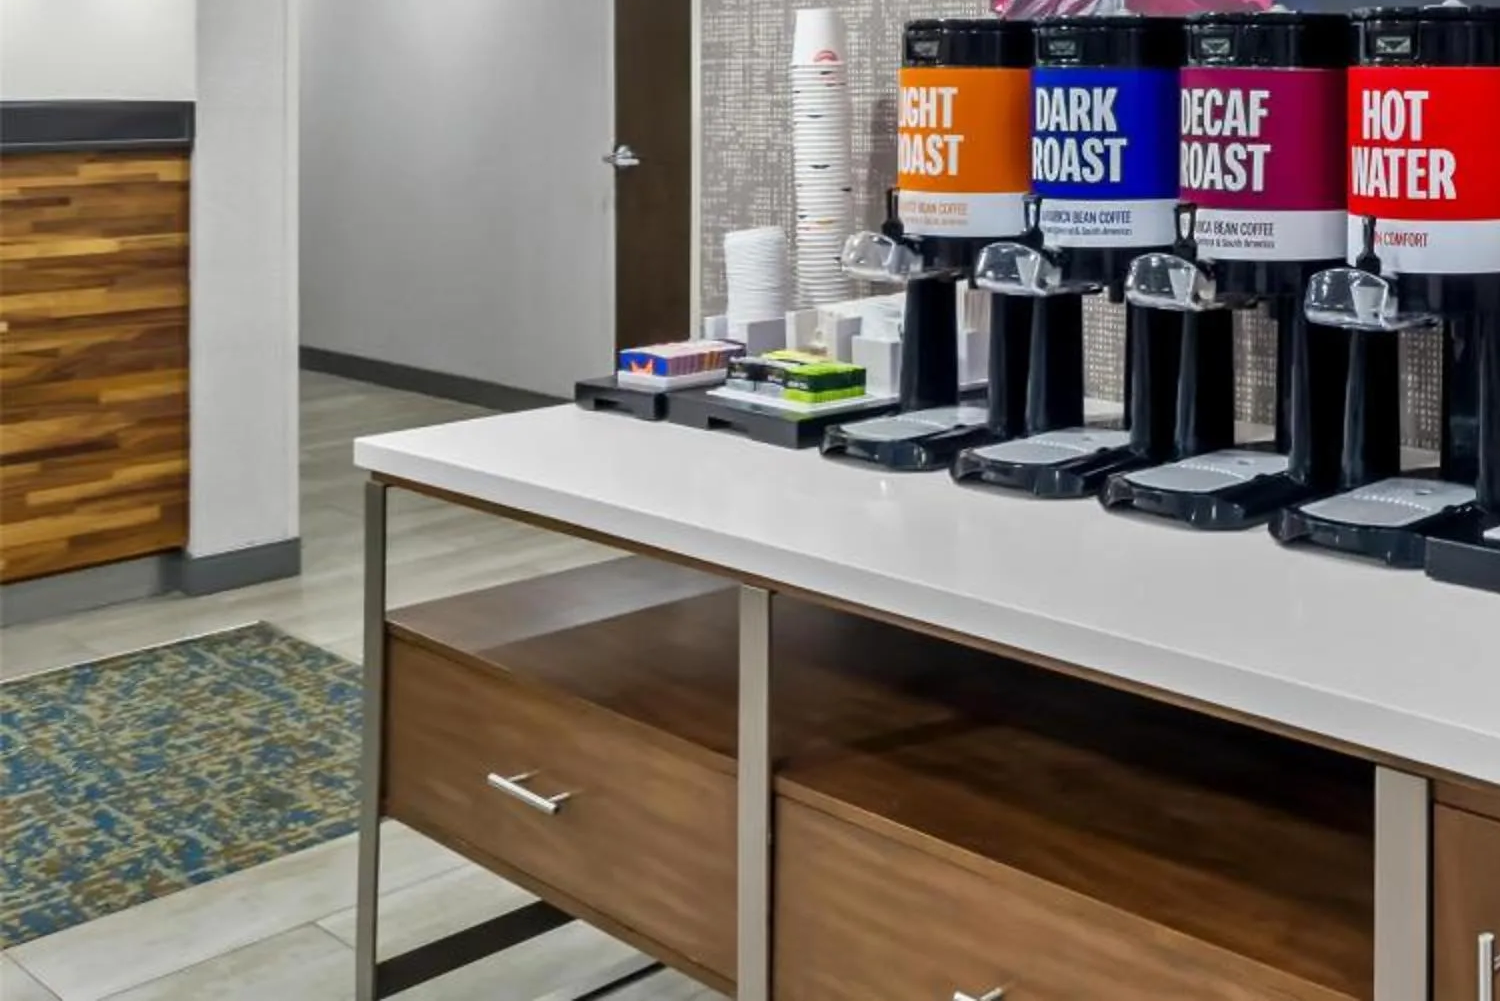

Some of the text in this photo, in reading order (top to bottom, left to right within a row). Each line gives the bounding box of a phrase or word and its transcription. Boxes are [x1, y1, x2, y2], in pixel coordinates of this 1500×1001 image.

[898, 86, 959, 128] IGHT
[1036, 86, 1118, 132] DARK
[1180, 88, 1270, 137] DECAF
[1362, 89, 1430, 141] HOT
[897, 132, 965, 177] OAST
[1032, 137, 1128, 183] ROAST
[1180, 140, 1271, 192] ROAST
[1351, 146, 1457, 200] WATER
[1072, 210, 1096, 224] BEAN
[1098, 210, 1132, 224] COFFEE
[1213, 221, 1238, 235] BEAN
[1239, 222, 1274, 237] COFFEE
[1383, 232, 1429, 247] COMFORT
